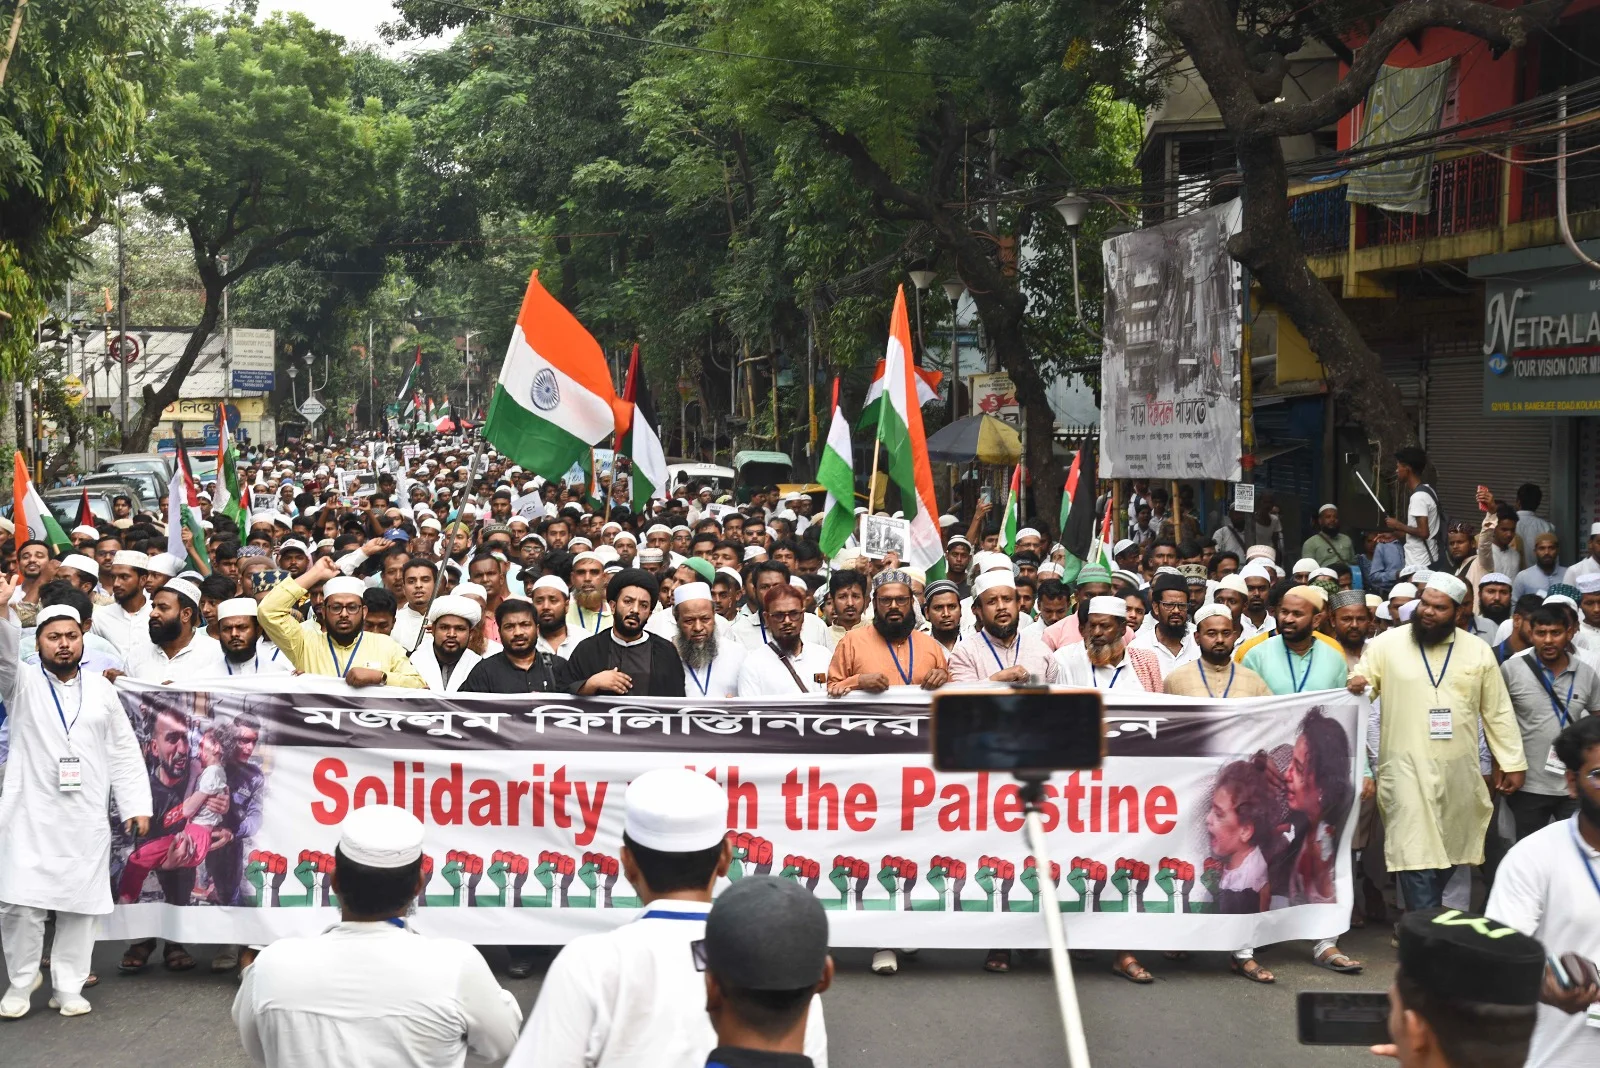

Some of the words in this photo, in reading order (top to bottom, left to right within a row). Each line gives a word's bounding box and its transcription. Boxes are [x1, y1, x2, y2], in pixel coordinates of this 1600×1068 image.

[1512, 359, 1536, 377] YOUR
[1537, 358, 1566, 377] VISION
[1568, 356, 1588, 375] OUR
[293, 706, 512, 739] মজলুম
[525, 705, 931, 737] ফিলিস্তিনিদের
[310, 756, 609, 846] Solidarity
[781, 765, 878, 832] the
[900, 766, 1178, 835] Palestine
